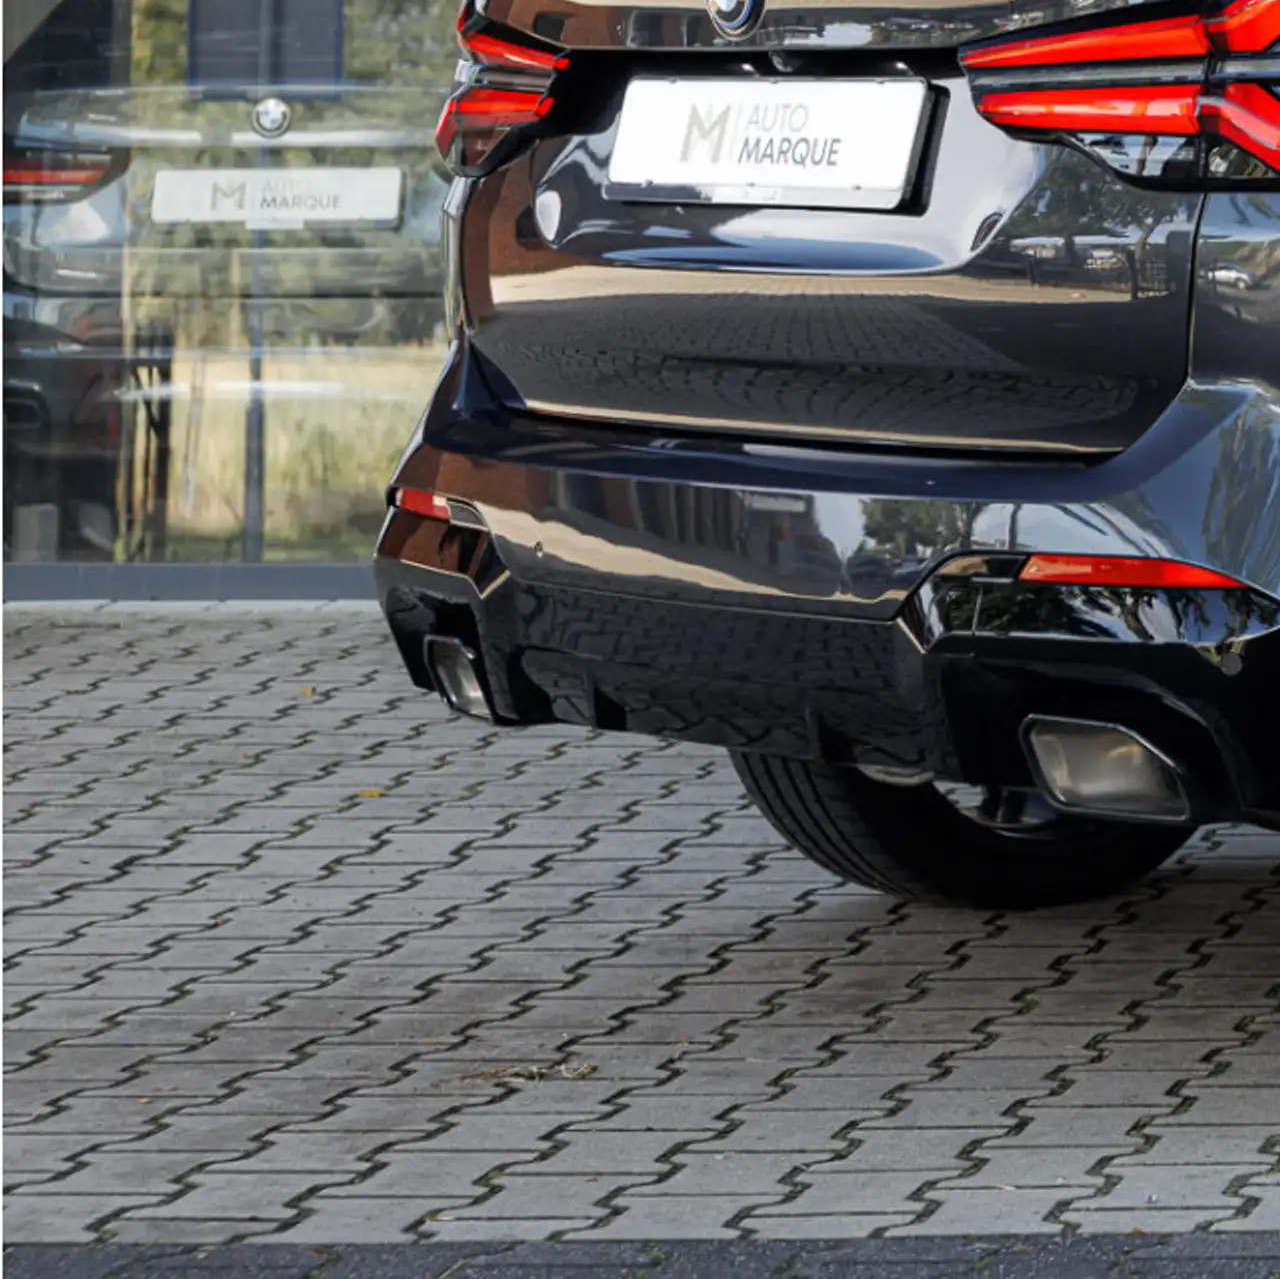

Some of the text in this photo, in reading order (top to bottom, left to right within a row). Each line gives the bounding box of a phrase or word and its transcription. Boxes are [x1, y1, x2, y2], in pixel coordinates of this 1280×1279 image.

[744, 103, 810, 133] AUTO
[737, 135, 843, 168] MARQUE
[260, 194, 341, 212] MARQUE
